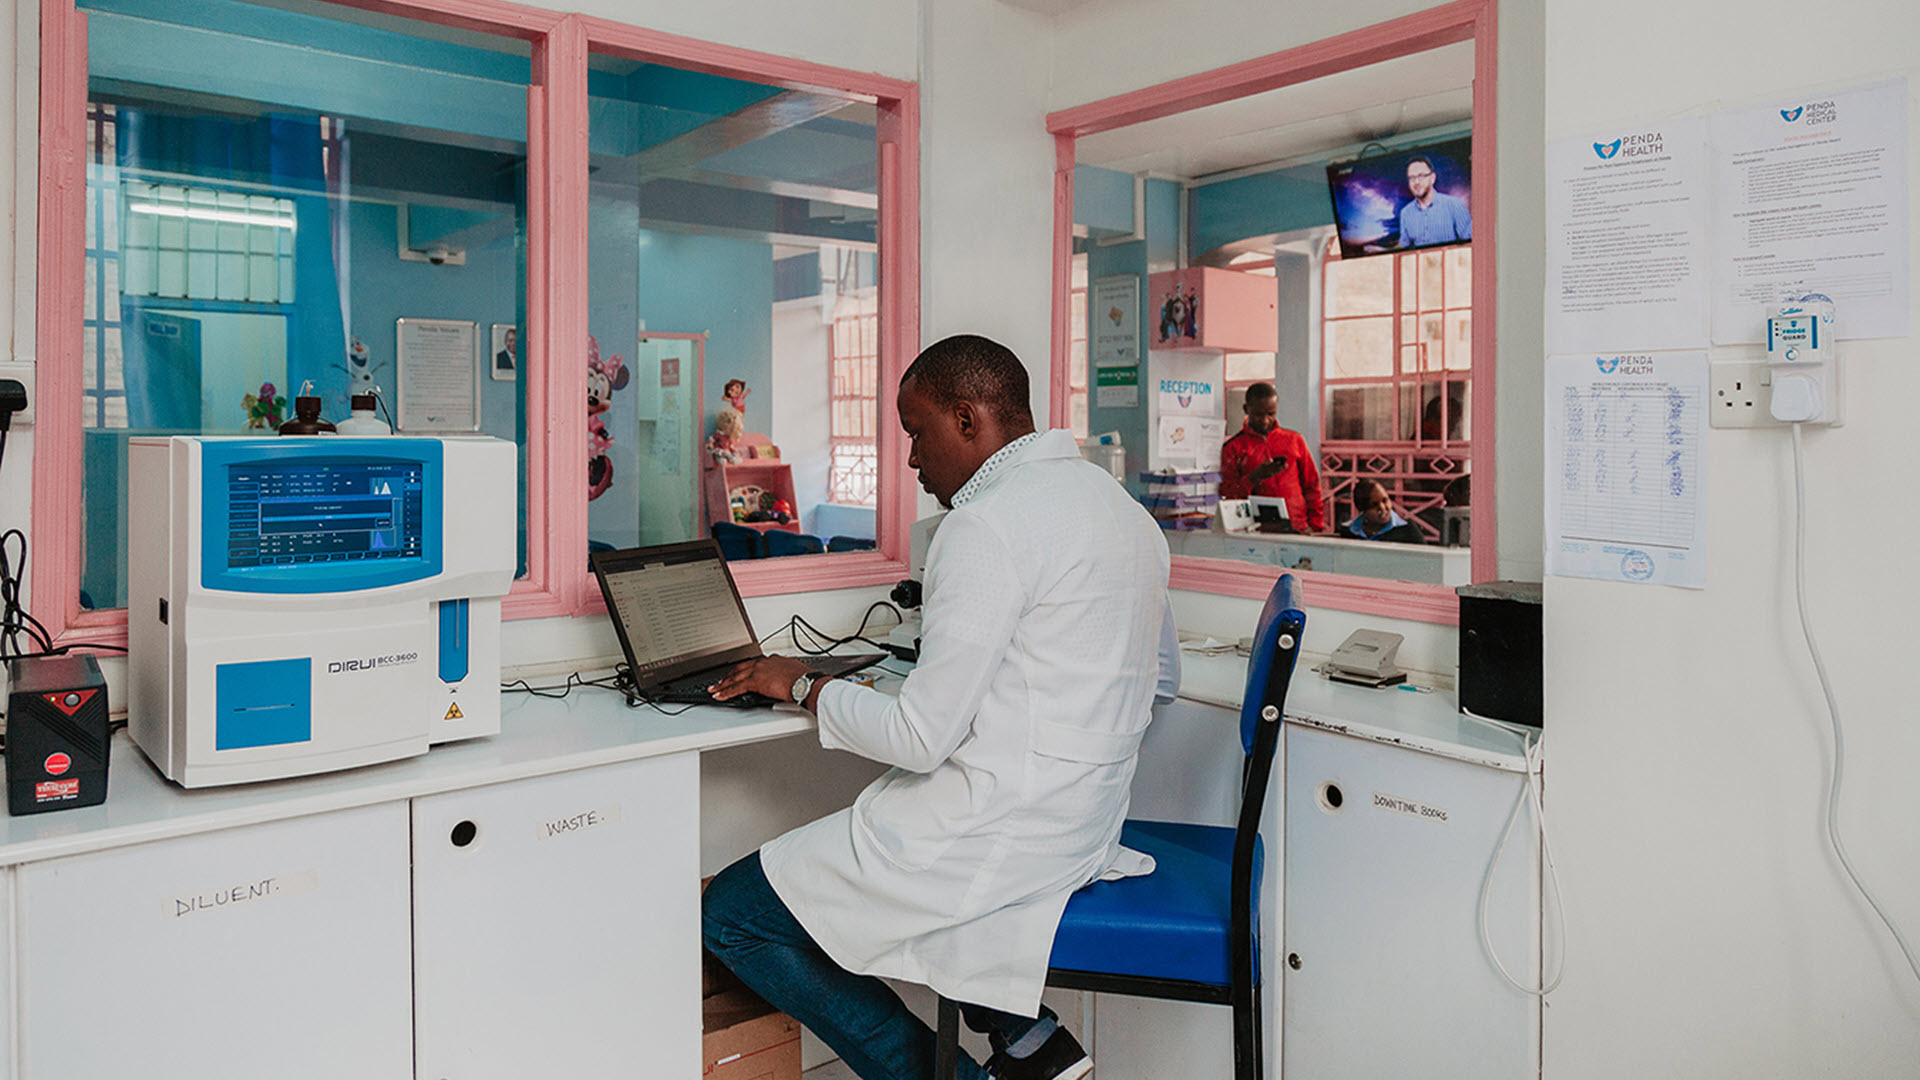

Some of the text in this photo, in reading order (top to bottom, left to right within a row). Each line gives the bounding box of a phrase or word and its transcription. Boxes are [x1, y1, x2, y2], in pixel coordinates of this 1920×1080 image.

[1806, 101, 1835, 111] PENDA
[1805, 114, 1837, 126] CENTER
[1806, 108, 1837, 119] MEDICAL
[1622, 132, 1663, 146] PENDA
[1622, 143, 1664, 158] HEALTH
[1620, 355, 1653, 365] PENDA
[1619, 365, 1653, 375] HEALTH
[1160, 379, 1212, 395] RECEPTION
[328, 657, 376, 673] DIRUI
[377, 652, 418, 664] BCC-3600
[1374, 794, 1448, 821] DOWNTIME BOOKS
